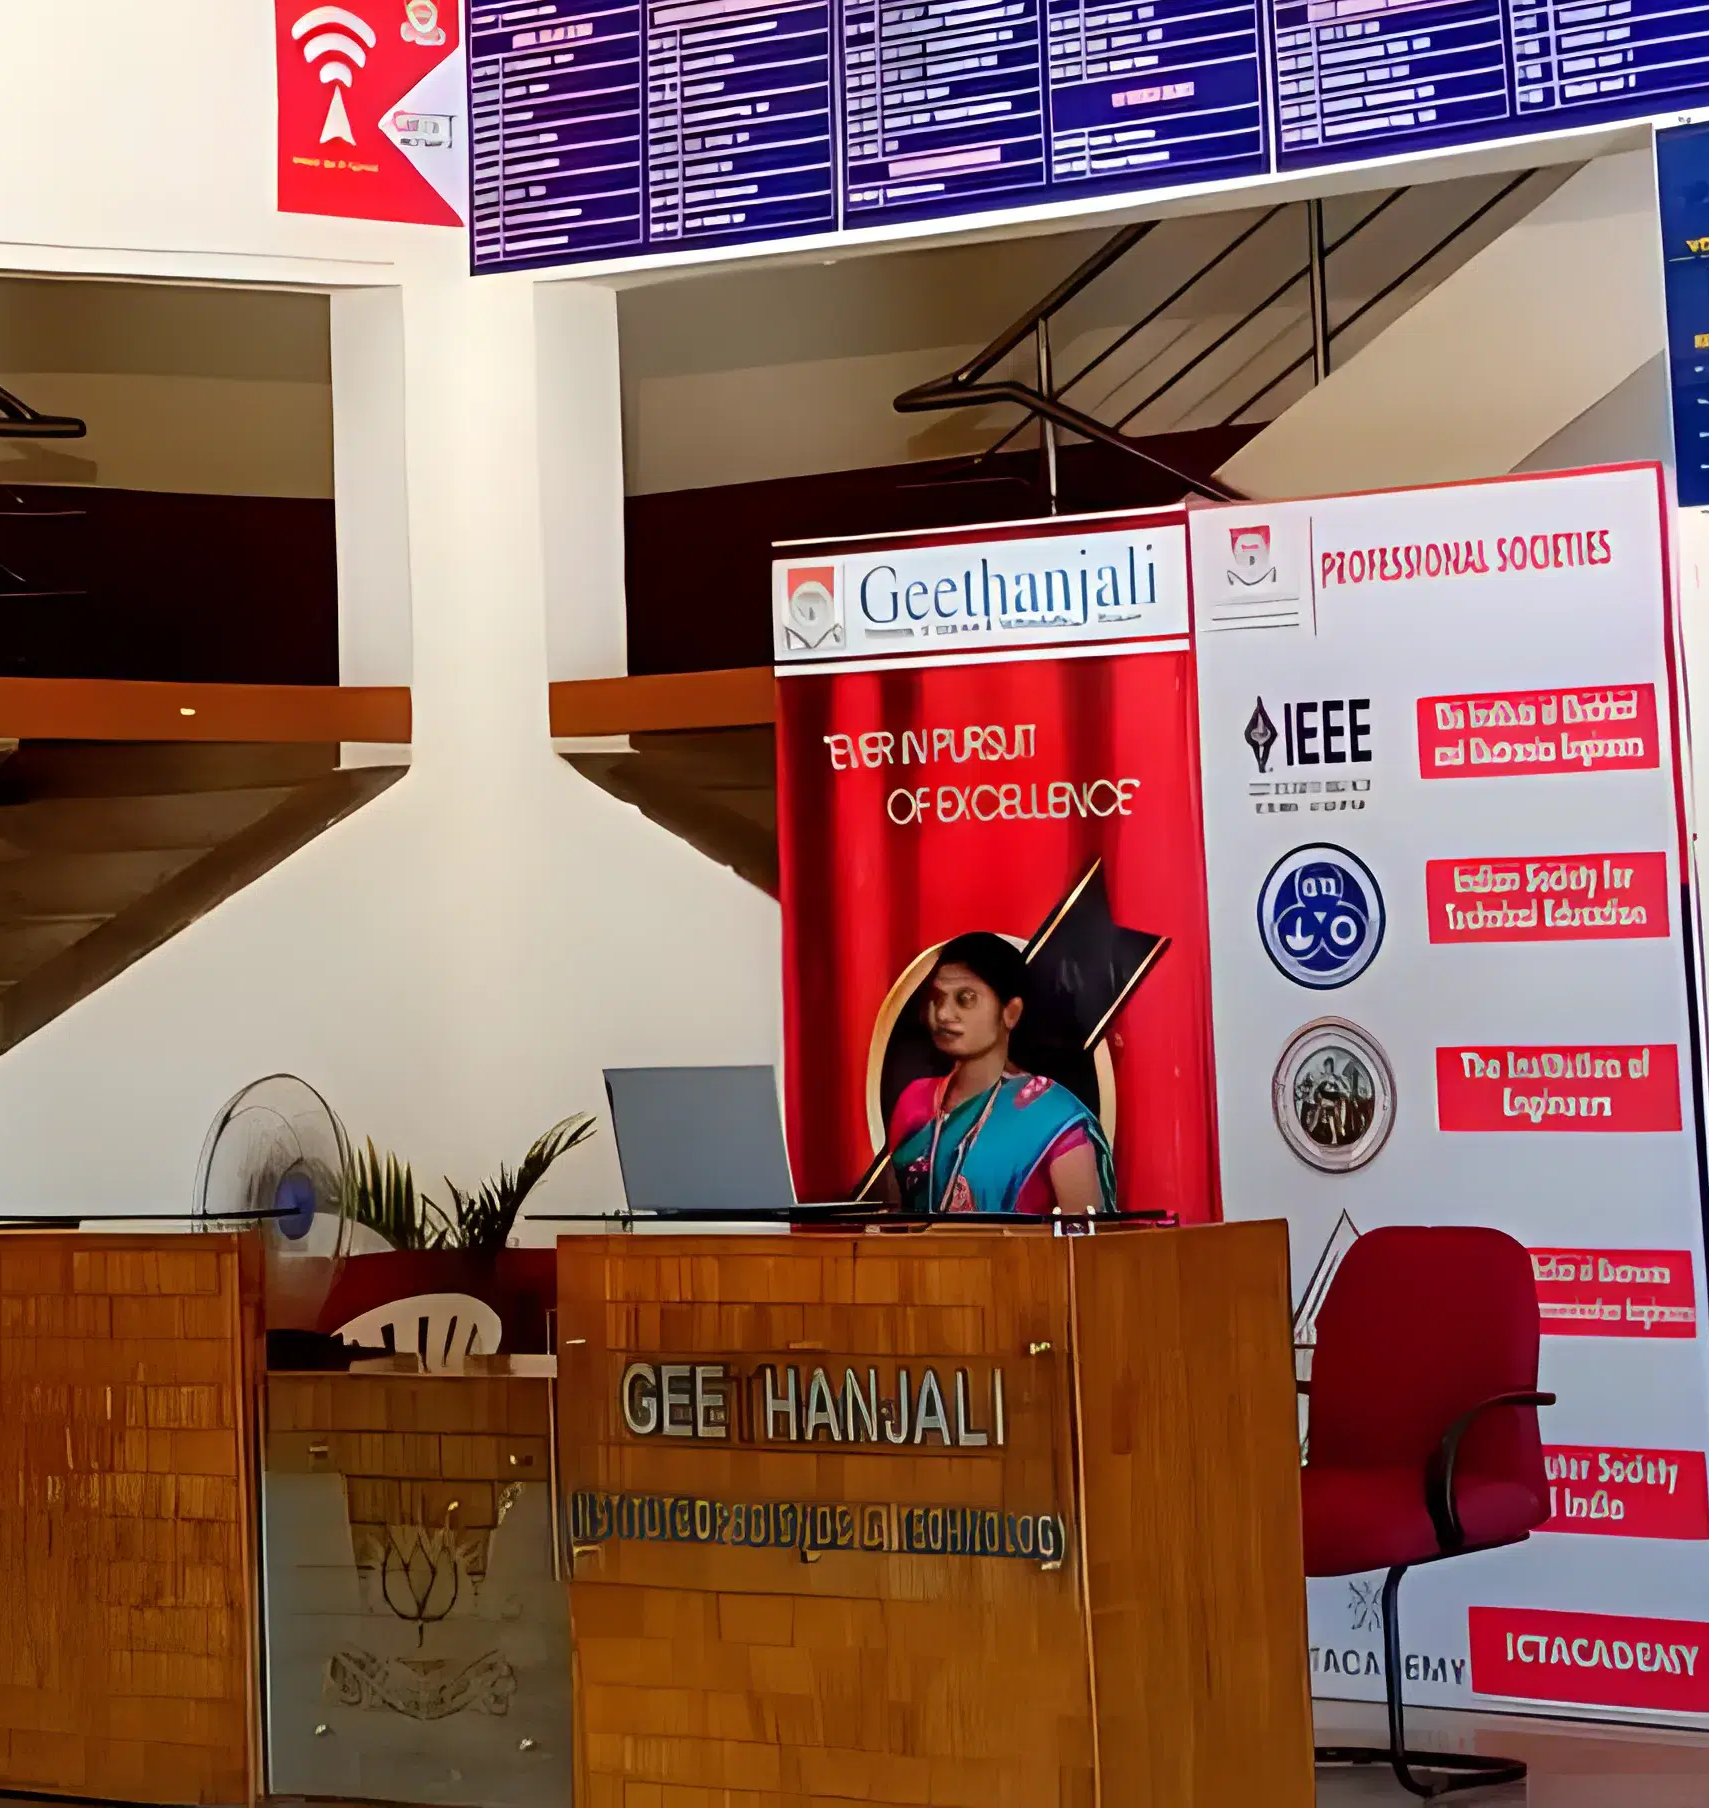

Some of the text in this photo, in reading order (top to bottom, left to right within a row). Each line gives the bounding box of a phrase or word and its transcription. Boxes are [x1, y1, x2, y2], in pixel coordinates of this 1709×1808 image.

[860, 544, 1157, 625] Geethanjali
[1321, 530, 1611, 588] PROFESSIONAL SOCIETIES
[1285, 699, 1372, 767] IEEE
[887, 779, 1141, 825] OF EXCELLENCE
[1507, 1631, 1700, 1678] ICTACADEMY
